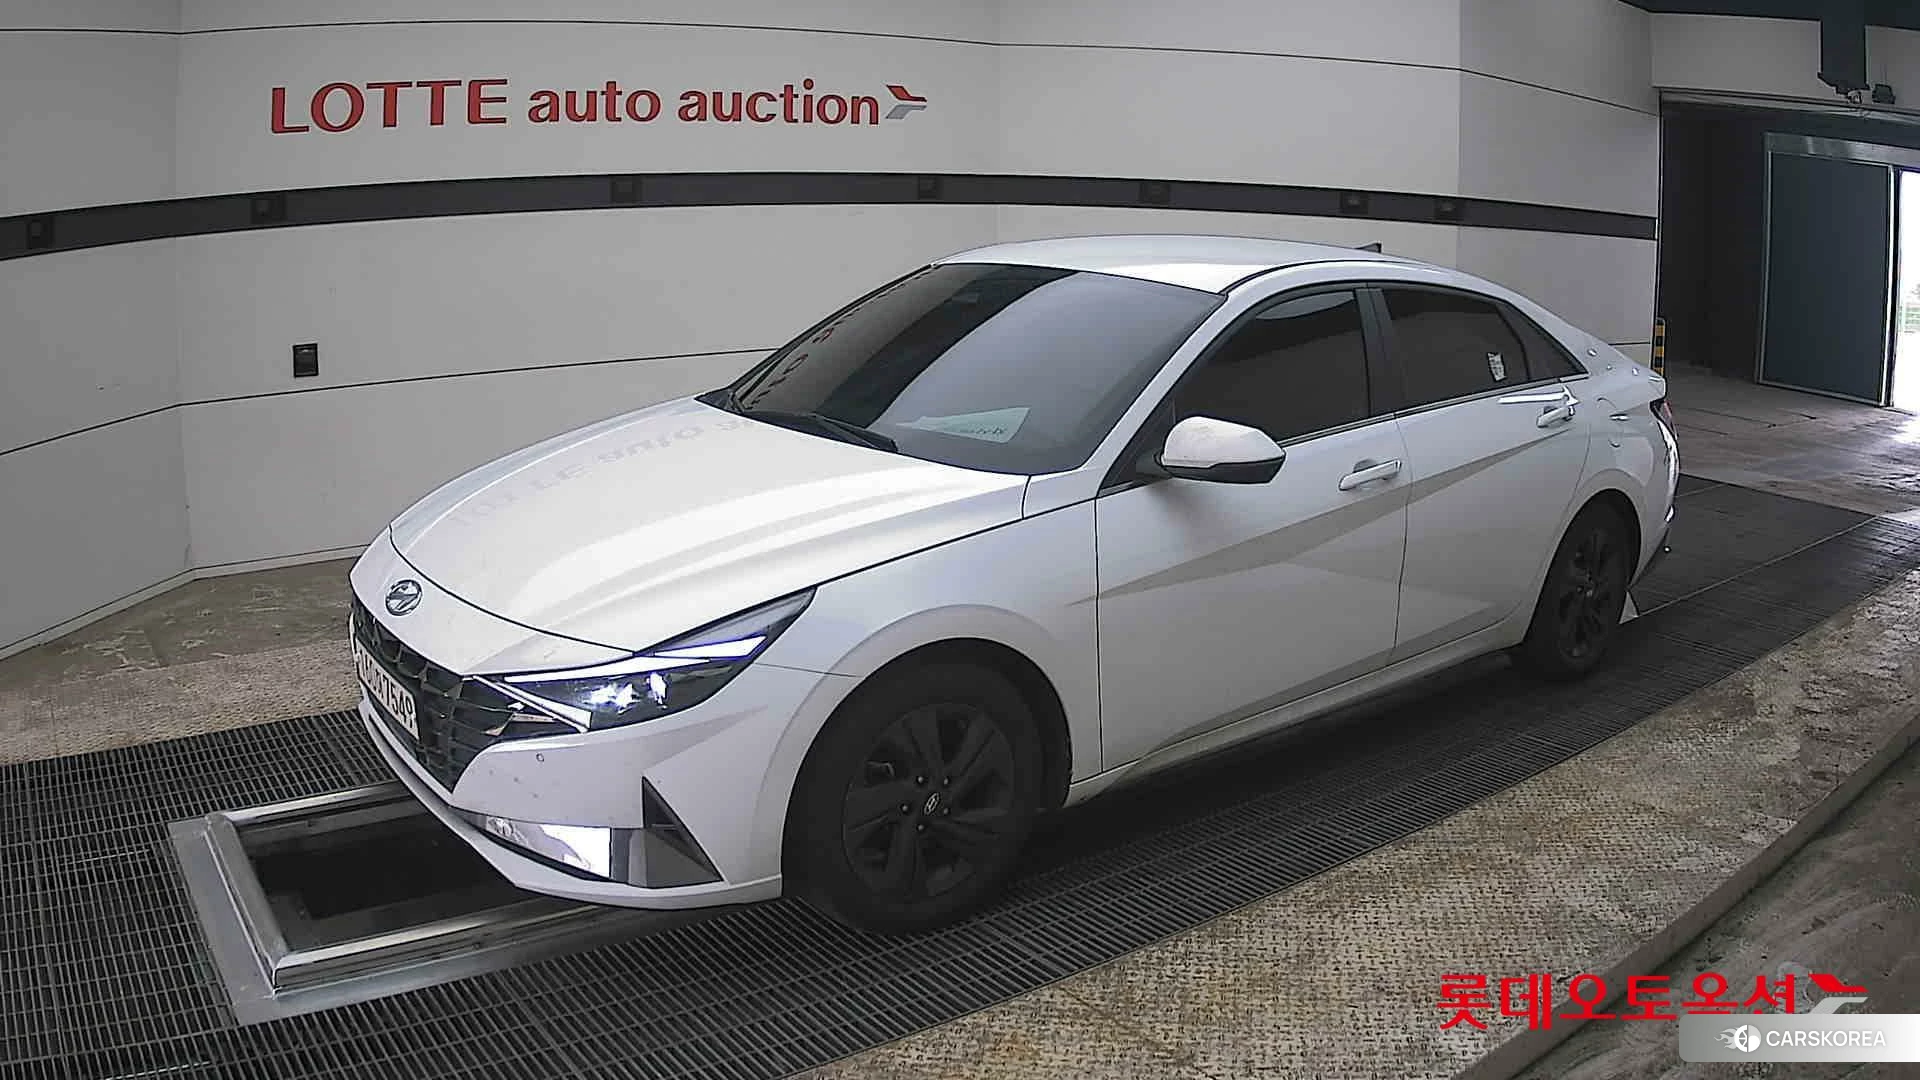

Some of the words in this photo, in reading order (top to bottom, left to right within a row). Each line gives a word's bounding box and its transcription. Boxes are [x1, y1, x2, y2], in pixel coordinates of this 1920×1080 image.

[271, 79, 507, 134] LOTTE
[528, 81, 661, 123] auto
[679, 79, 879, 125] auction
